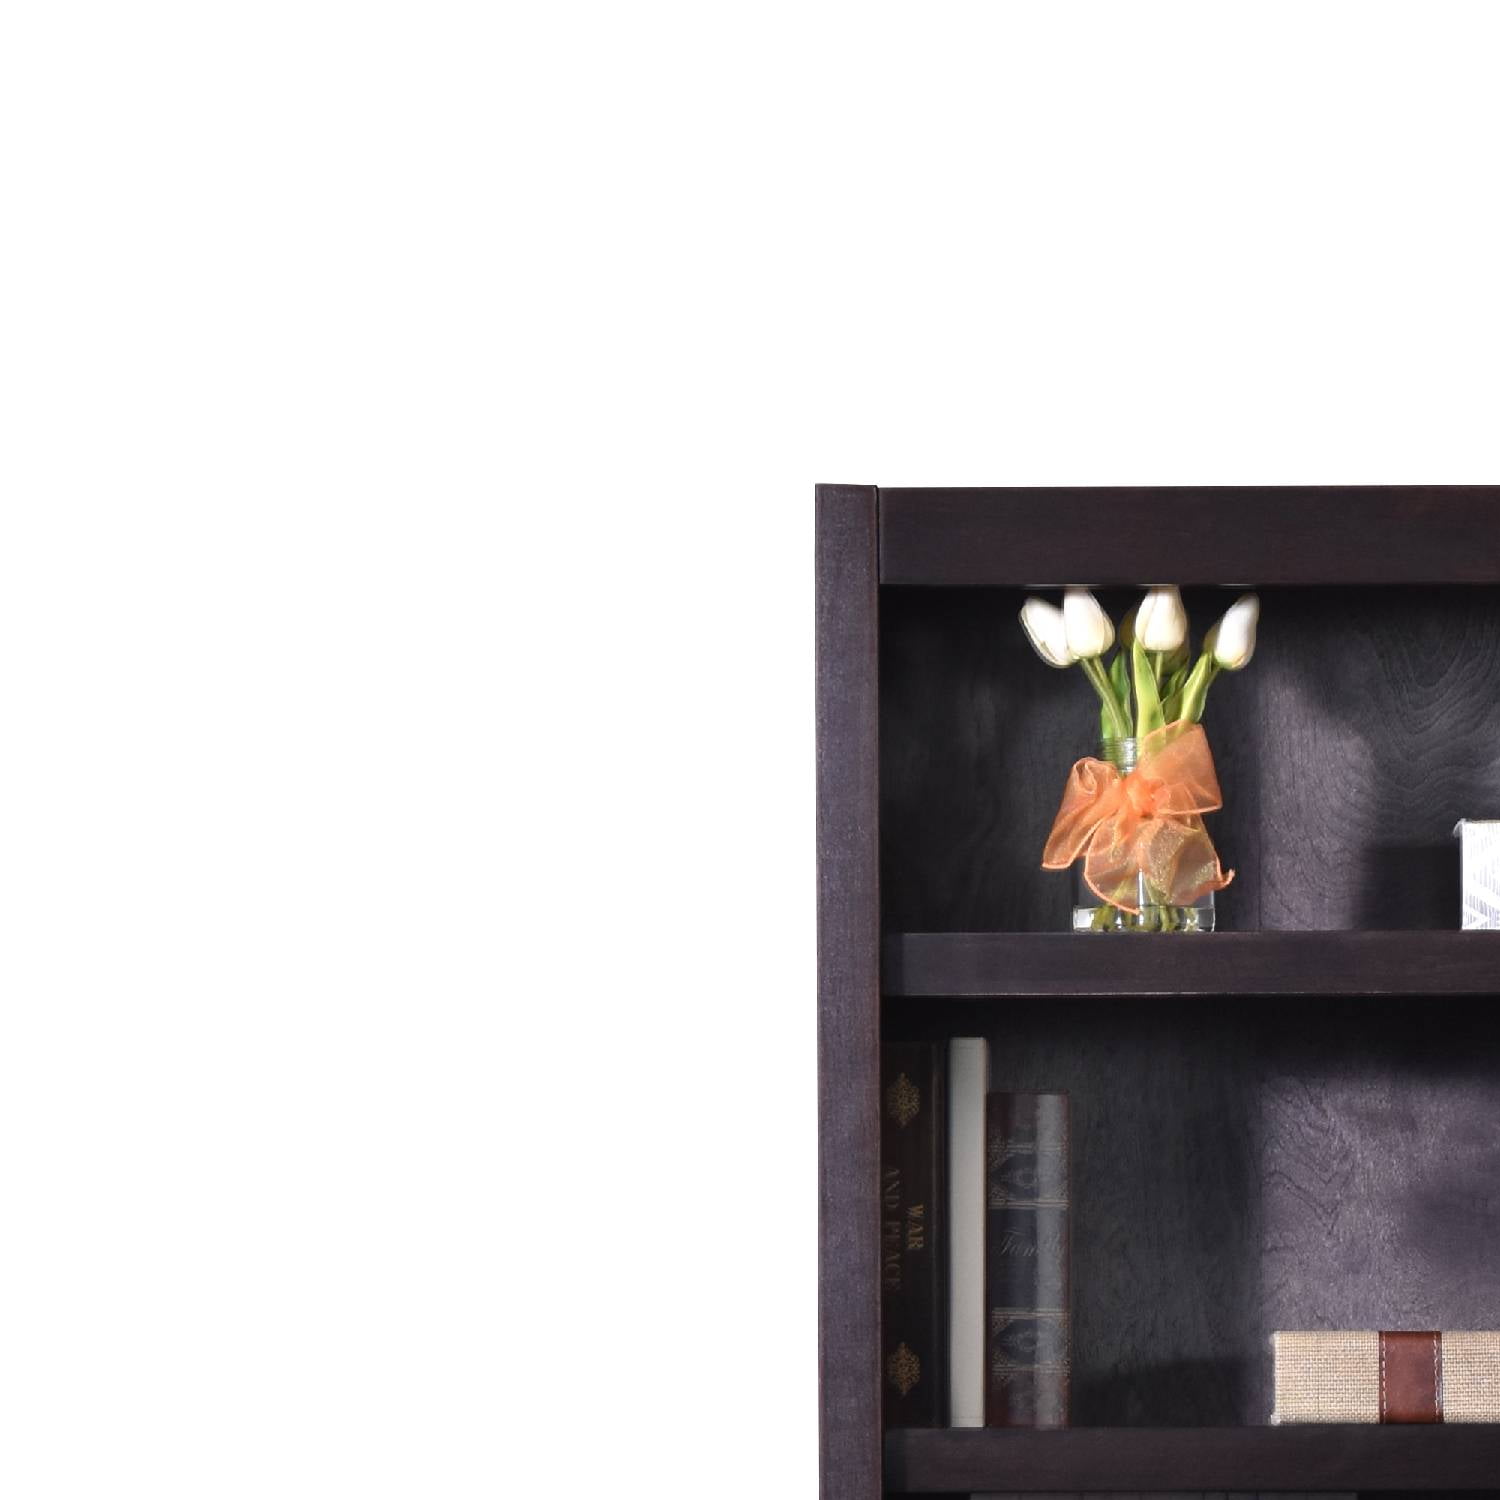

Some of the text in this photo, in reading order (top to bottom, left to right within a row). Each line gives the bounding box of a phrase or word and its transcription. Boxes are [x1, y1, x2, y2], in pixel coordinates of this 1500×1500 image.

[884, 1166, 902, 1291] AND PEACE
[906, 1203, 925, 1250] WAR
